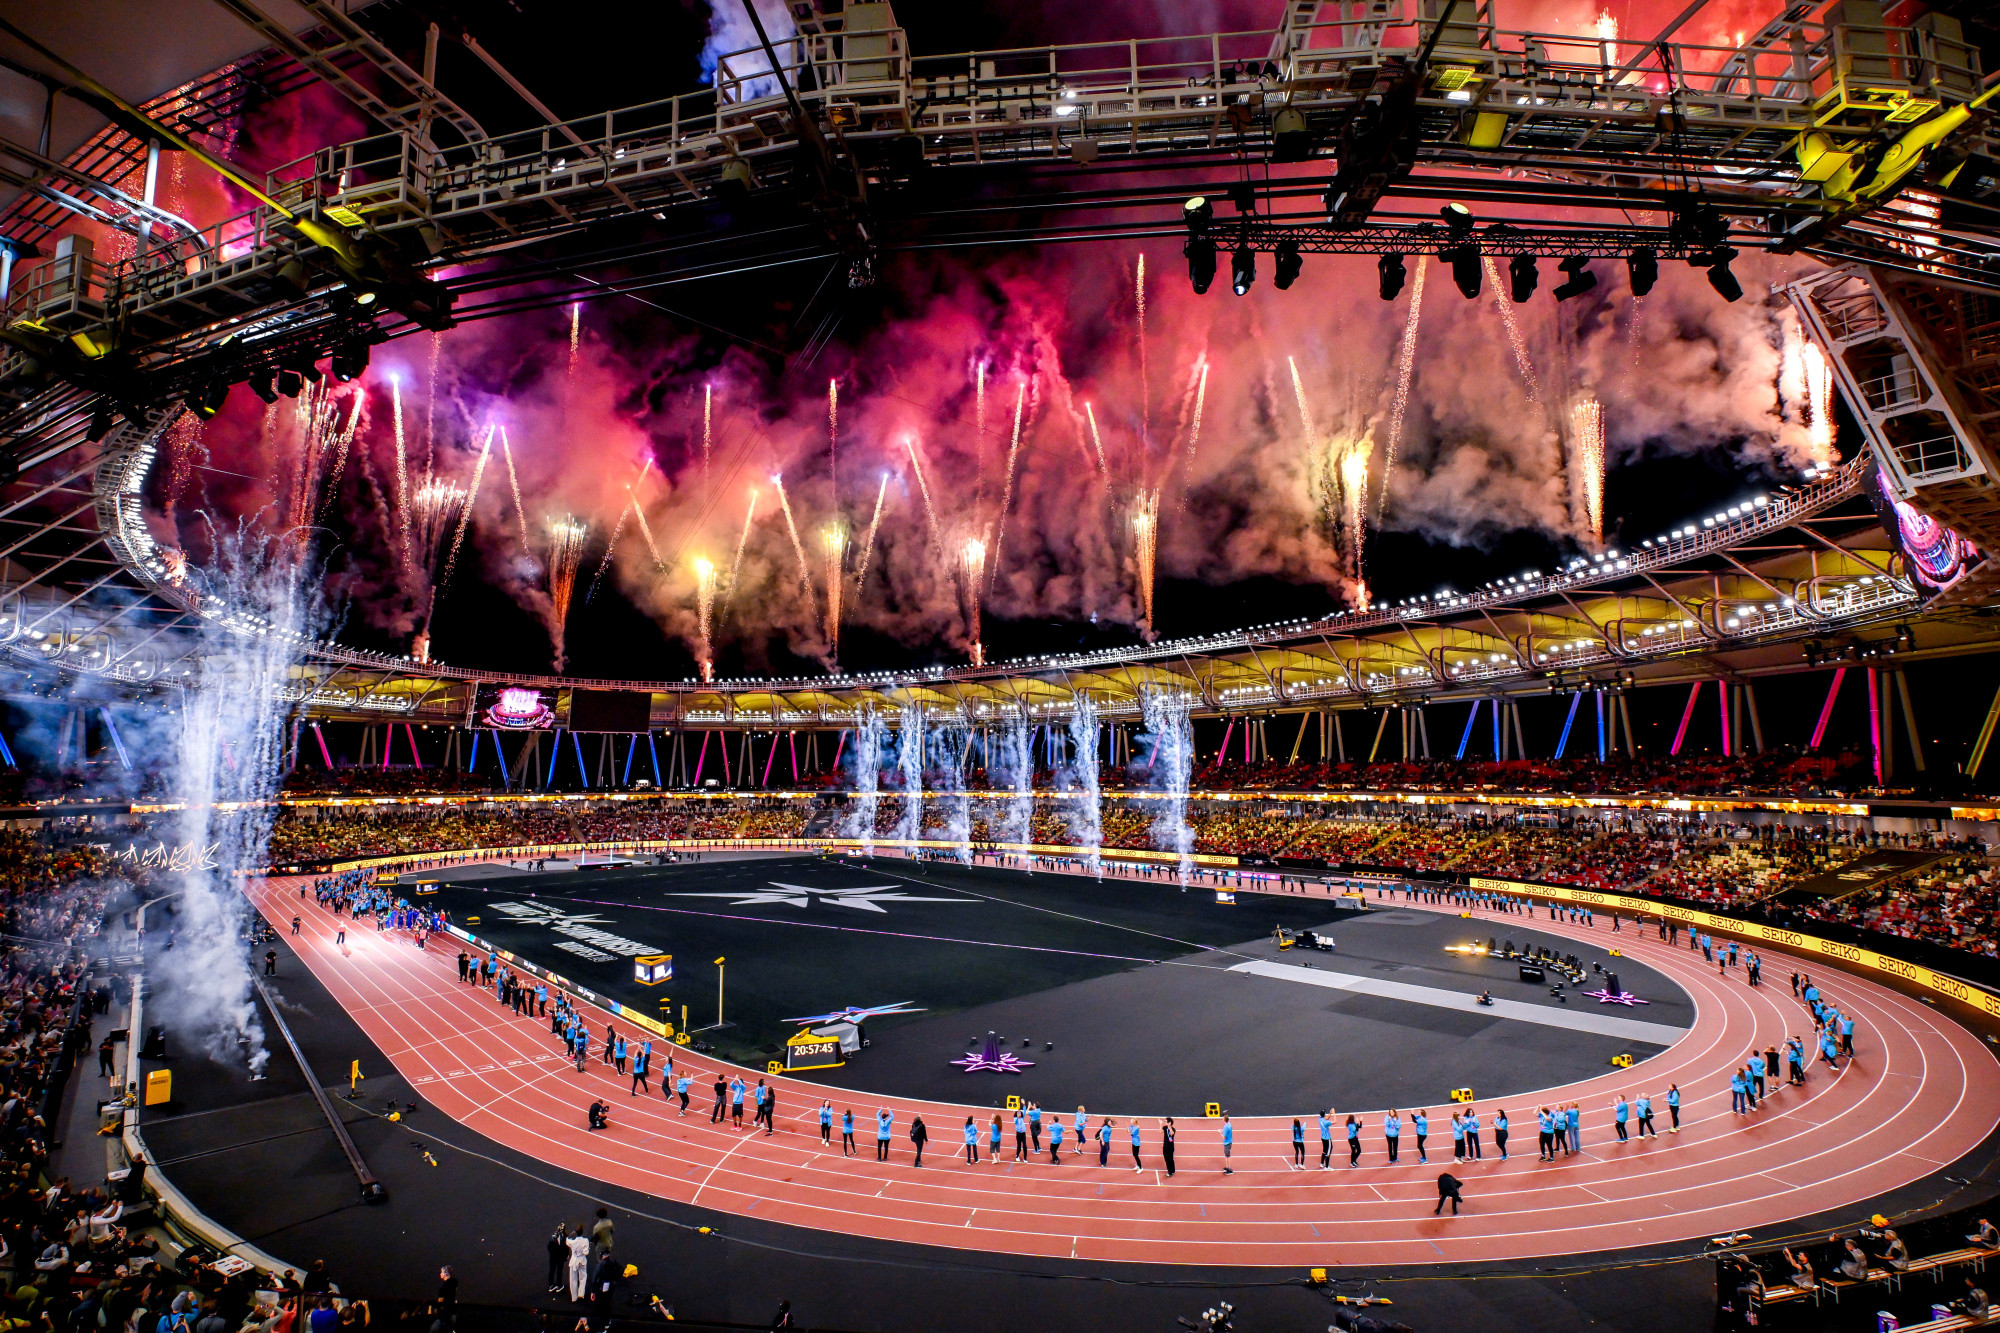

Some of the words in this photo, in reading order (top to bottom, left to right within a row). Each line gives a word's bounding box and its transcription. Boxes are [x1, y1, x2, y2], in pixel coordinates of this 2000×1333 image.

[1115, 849, 1136, 857] SEIKO
[1144, 851, 1166, 859] SEIKO
[1477, 879, 1510, 891] SEIKO
[1524, 885, 1556, 897] SEIKO
[1571, 891, 1604, 904] SEIKO
[1619, 897, 1650, 911] SEIKO
[1663, 905, 1695, 921] SEIKO
[1709, 915, 1745, 933] SEIKO
[1761, 927, 1803, 946] SEIKO
[1821, 940, 1861, 961] SEIKO
[1878, 956, 1917, 980] SEIKO
[1931, 974, 1969, 1000] SEIKO
[794, 1043, 833, 1056] 20:57:45
